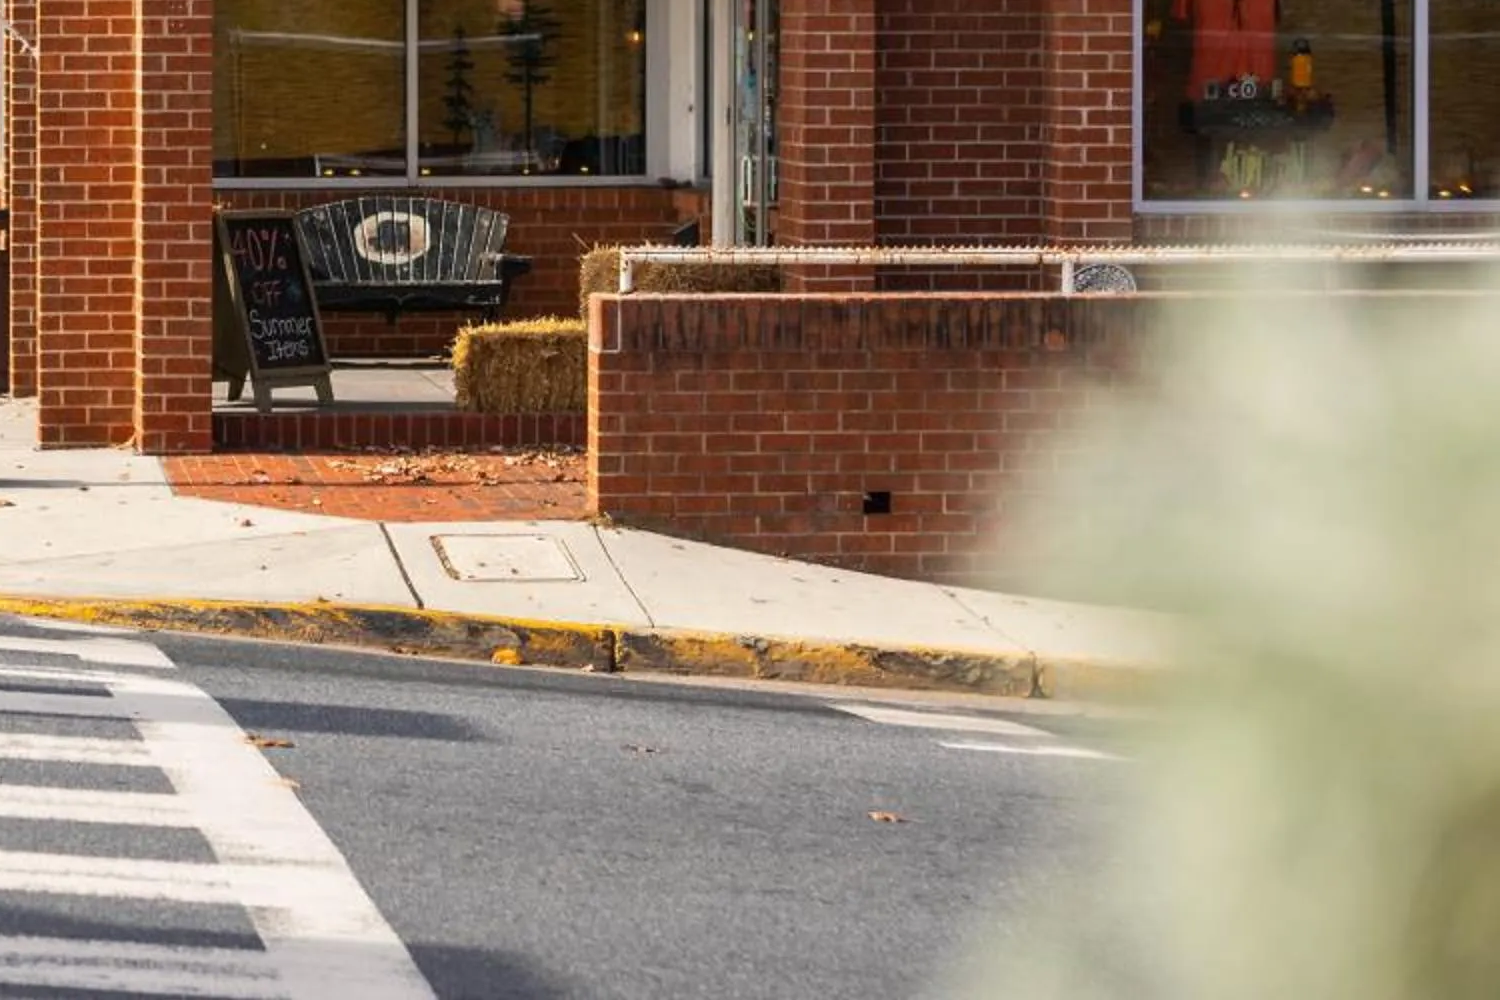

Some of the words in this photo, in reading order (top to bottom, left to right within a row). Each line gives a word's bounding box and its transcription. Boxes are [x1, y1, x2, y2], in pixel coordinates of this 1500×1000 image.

[231, 228, 288, 270] 40%
[252, 280, 282, 306] OFF
[249, 308, 313, 340] Summer
[264, 339, 309, 361] Items
